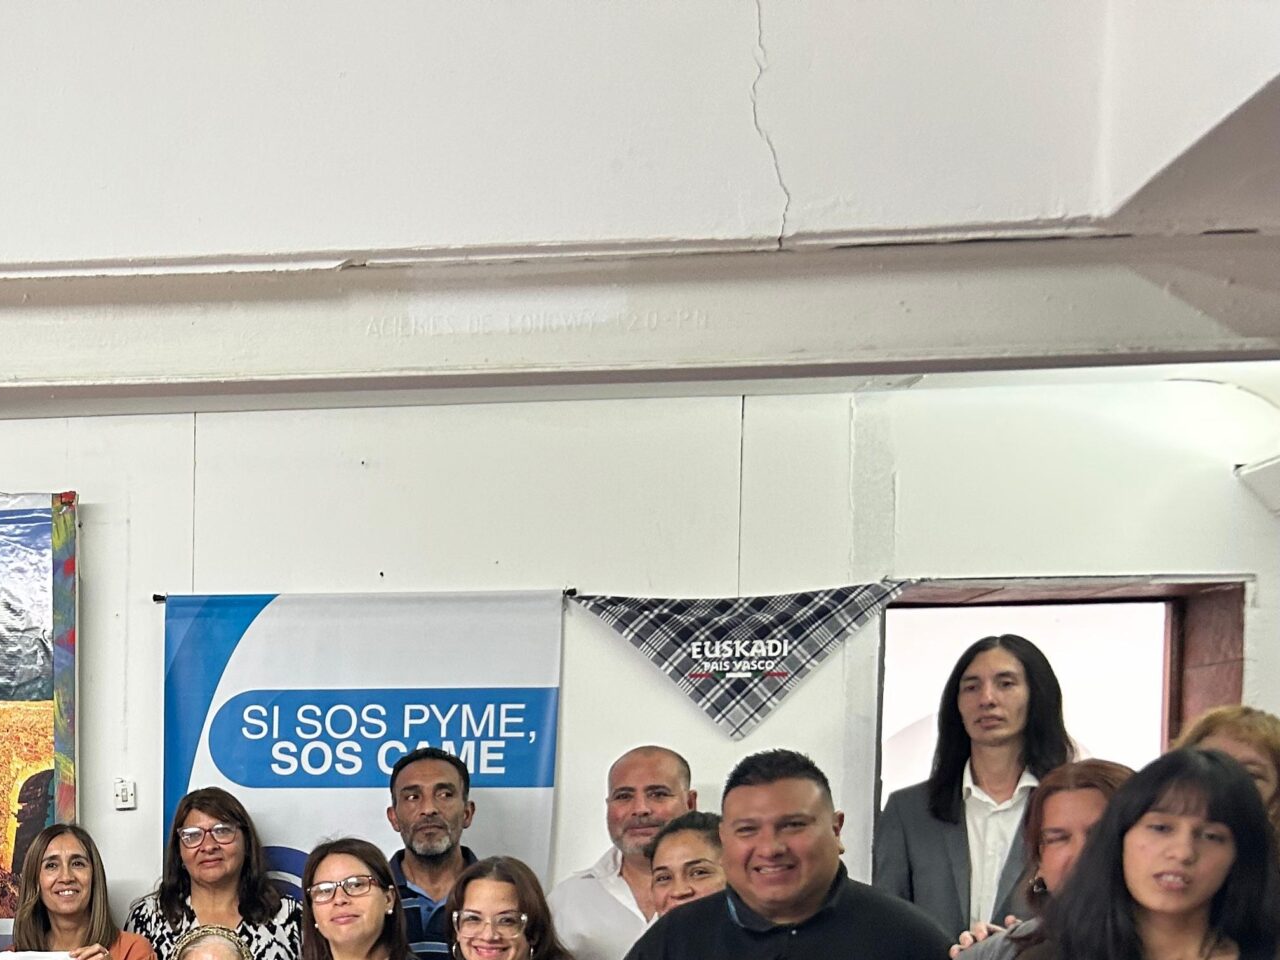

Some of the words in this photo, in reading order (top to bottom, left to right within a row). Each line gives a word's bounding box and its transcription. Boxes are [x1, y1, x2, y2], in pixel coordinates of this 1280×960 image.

[690, 639, 789, 659] EUSKADI
[732, 660, 775, 671] VASCO
[241, 704, 280, 739] SI
[295, 704, 387, 739] SOS
[403, 703, 537, 744] PYME,
[270, 740, 363, 776] SOS
[377, 740, 506, 775] CME
